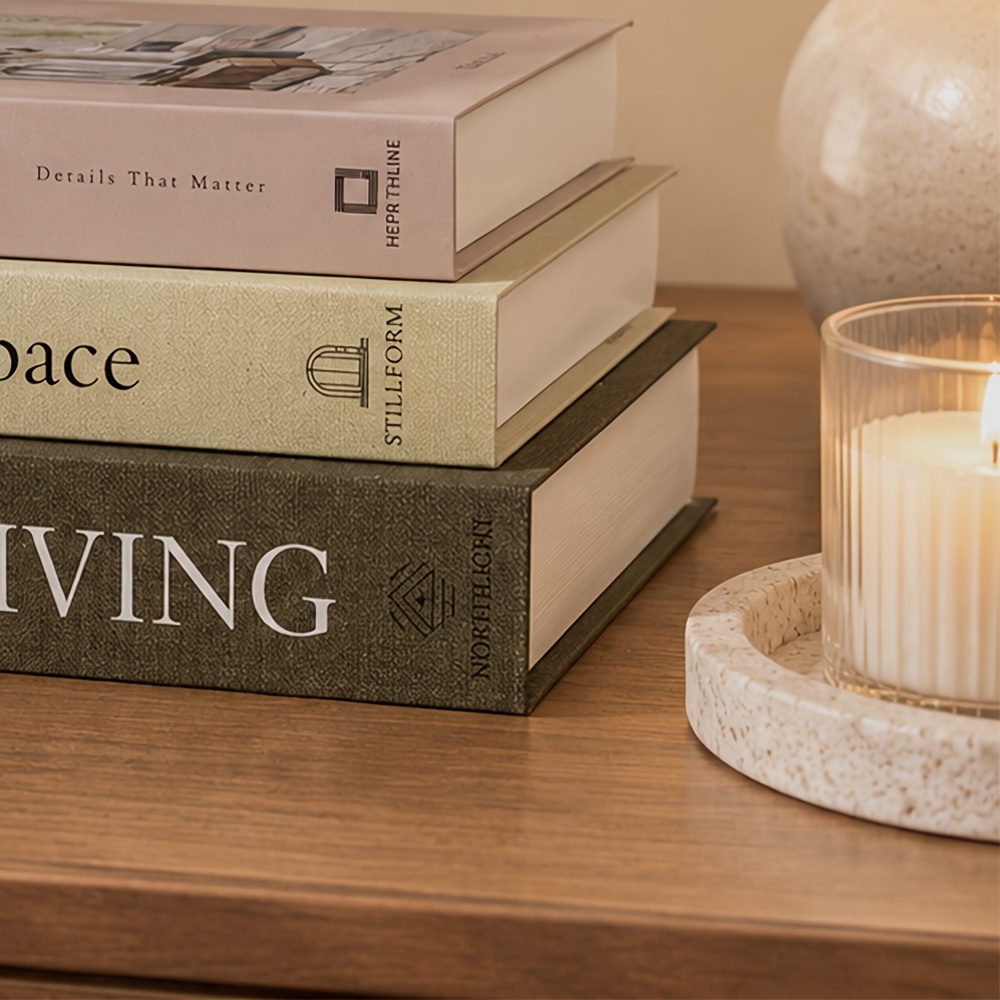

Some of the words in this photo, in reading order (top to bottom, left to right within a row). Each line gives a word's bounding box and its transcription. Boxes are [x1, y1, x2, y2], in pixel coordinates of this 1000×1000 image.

[36, 165, 115, 185] Details
[127, 170, 177, 189] That
[191, 174, 265, 193] Matter
[384, 304, 403, 446] STILLFORM
